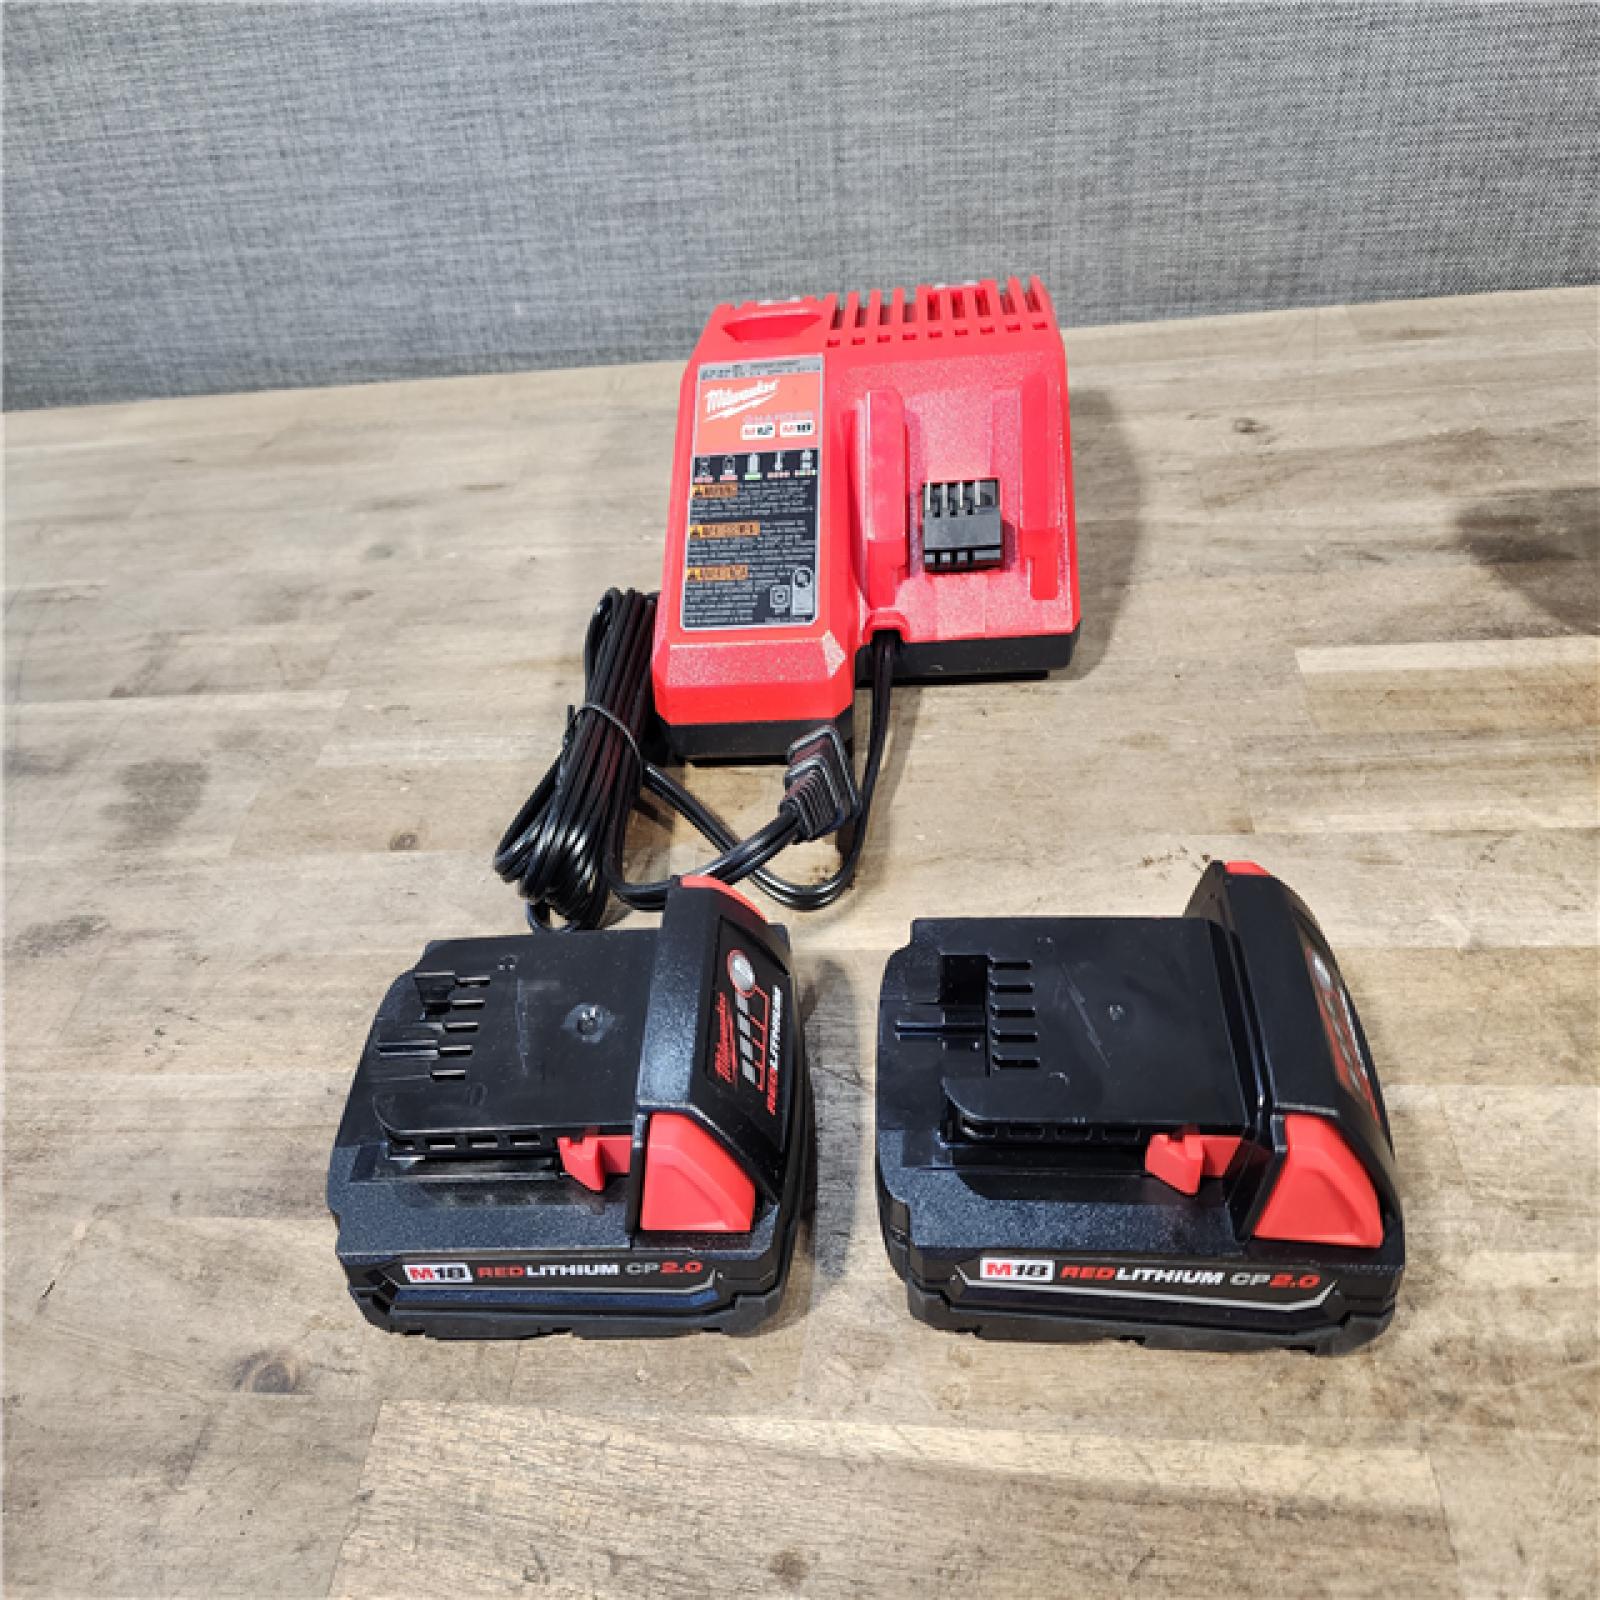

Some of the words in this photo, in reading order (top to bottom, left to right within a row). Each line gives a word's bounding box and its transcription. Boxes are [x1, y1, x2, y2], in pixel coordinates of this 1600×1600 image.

[408, 1265, 467, 1281] M18
[477, 1263, 620, 1279] REDLITHIUM
[624, 1259, 703, 1275] CP2.0
[985, 1262, 1050, 1278] M18
[1060, 1264, 1224, 1287] REDLITHIUM
[1229, 1272, 1321, 1289] CP2.0
